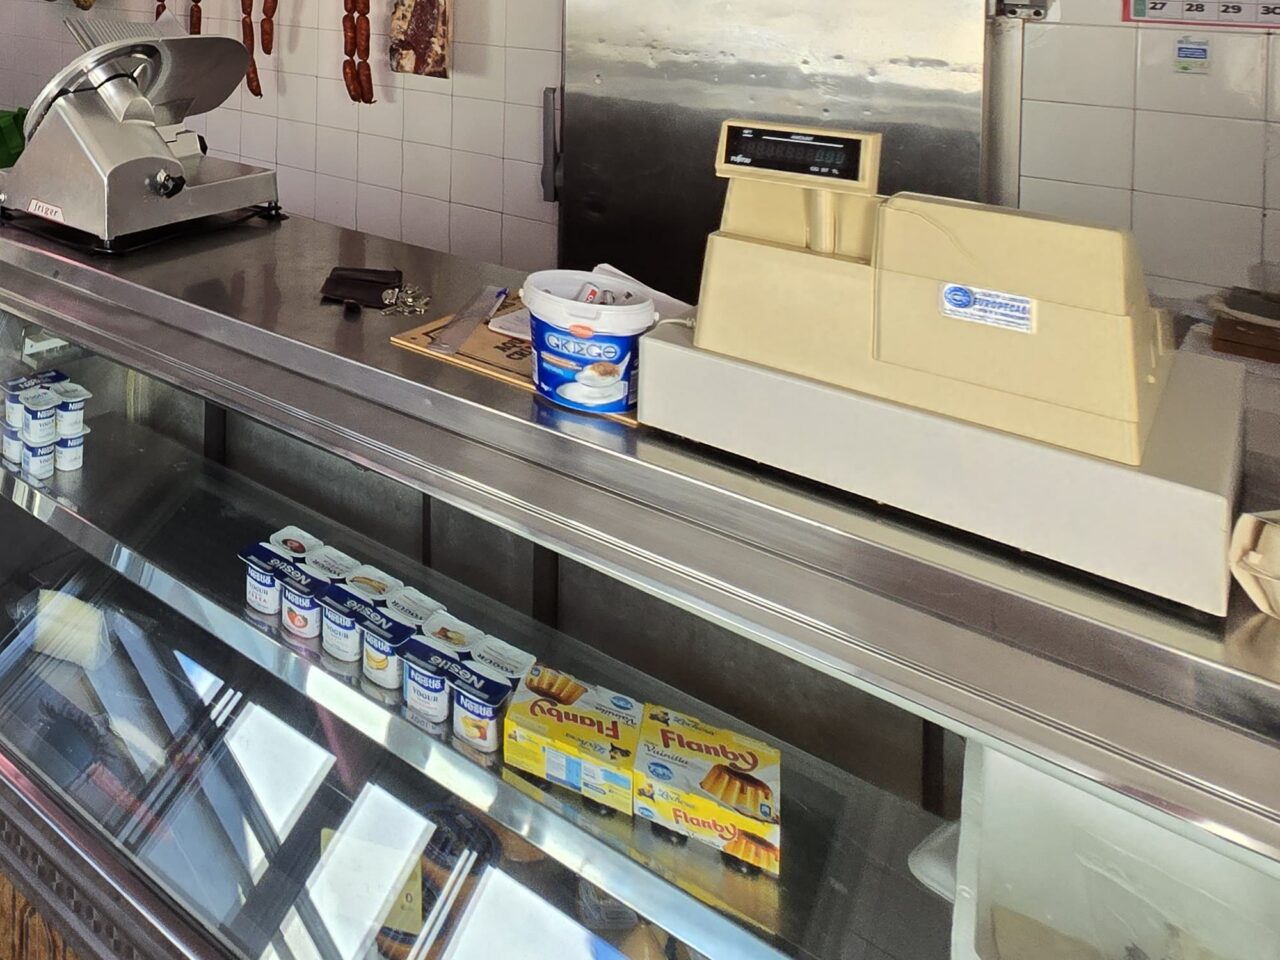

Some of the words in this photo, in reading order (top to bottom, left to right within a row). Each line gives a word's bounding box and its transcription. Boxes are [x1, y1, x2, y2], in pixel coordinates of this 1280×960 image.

[1149, 2, 1167, 10] 27
[1185, 3, 1205, 12] 28
[1221, 4, 1242, 13] 29
[1261, 6, 1280, 15] 30
[268, 558, 311, 585] Nestlé
[285, 589, 311, 608] Nestlé
[325, 608, 352, 628] Nestlé
[344, 600, 392, 630] Nestlé
[428, 656, 485, 689] Nestlé
[477, 653, 516, 674] YOGUR
[410, 670, 441, 689] Nestlé
[412, 687, 438, 703] YOGUR
[460, 695, 494, 717] Nestlé
[530, 698, 620, 740] Flanby
[660, 728, 759, 772] Flanby
[672, 807, 736, 841] Flanby
